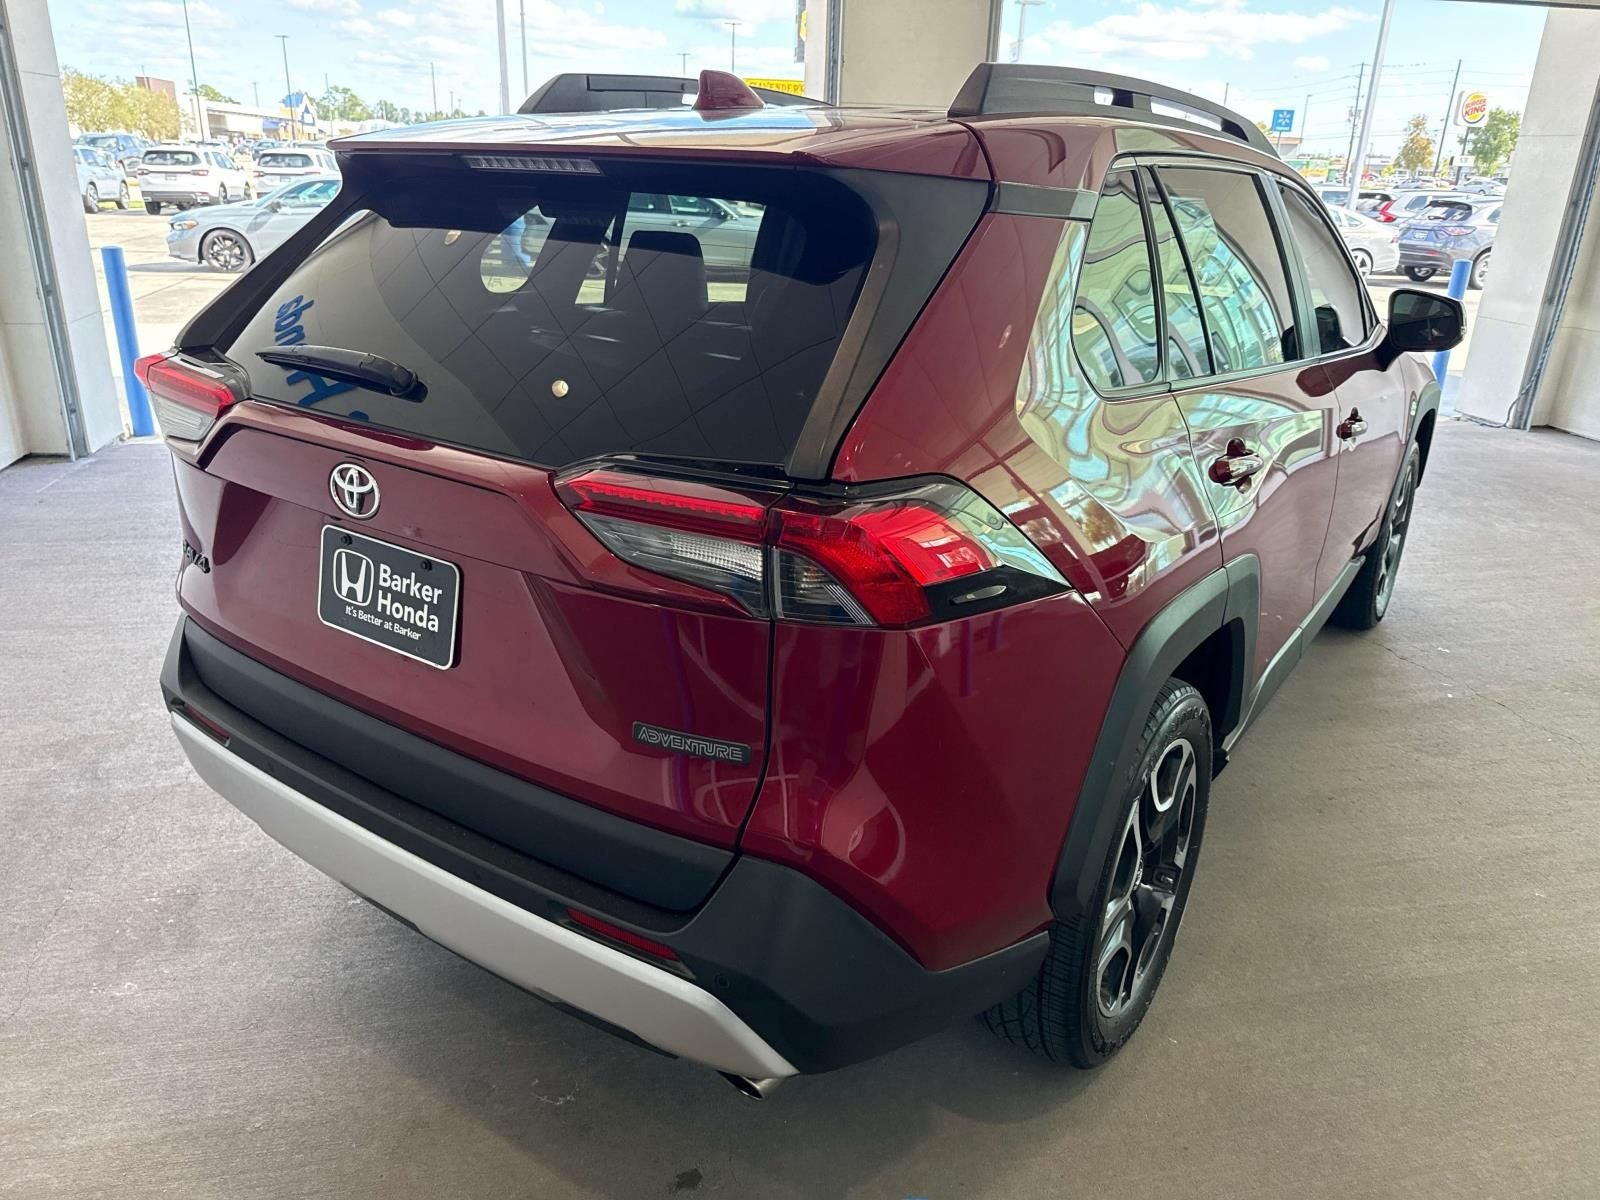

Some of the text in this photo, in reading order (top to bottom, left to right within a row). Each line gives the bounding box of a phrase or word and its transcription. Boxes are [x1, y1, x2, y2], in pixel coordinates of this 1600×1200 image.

[1465, 104, 1486, 117] KING
[378, 563, 443, 605] Barker
[345, 605, 422, 641] It's Better at Barker
[377, 590, 440, 633] Honda
[638, 726, 743, 761] ADVENTURE
